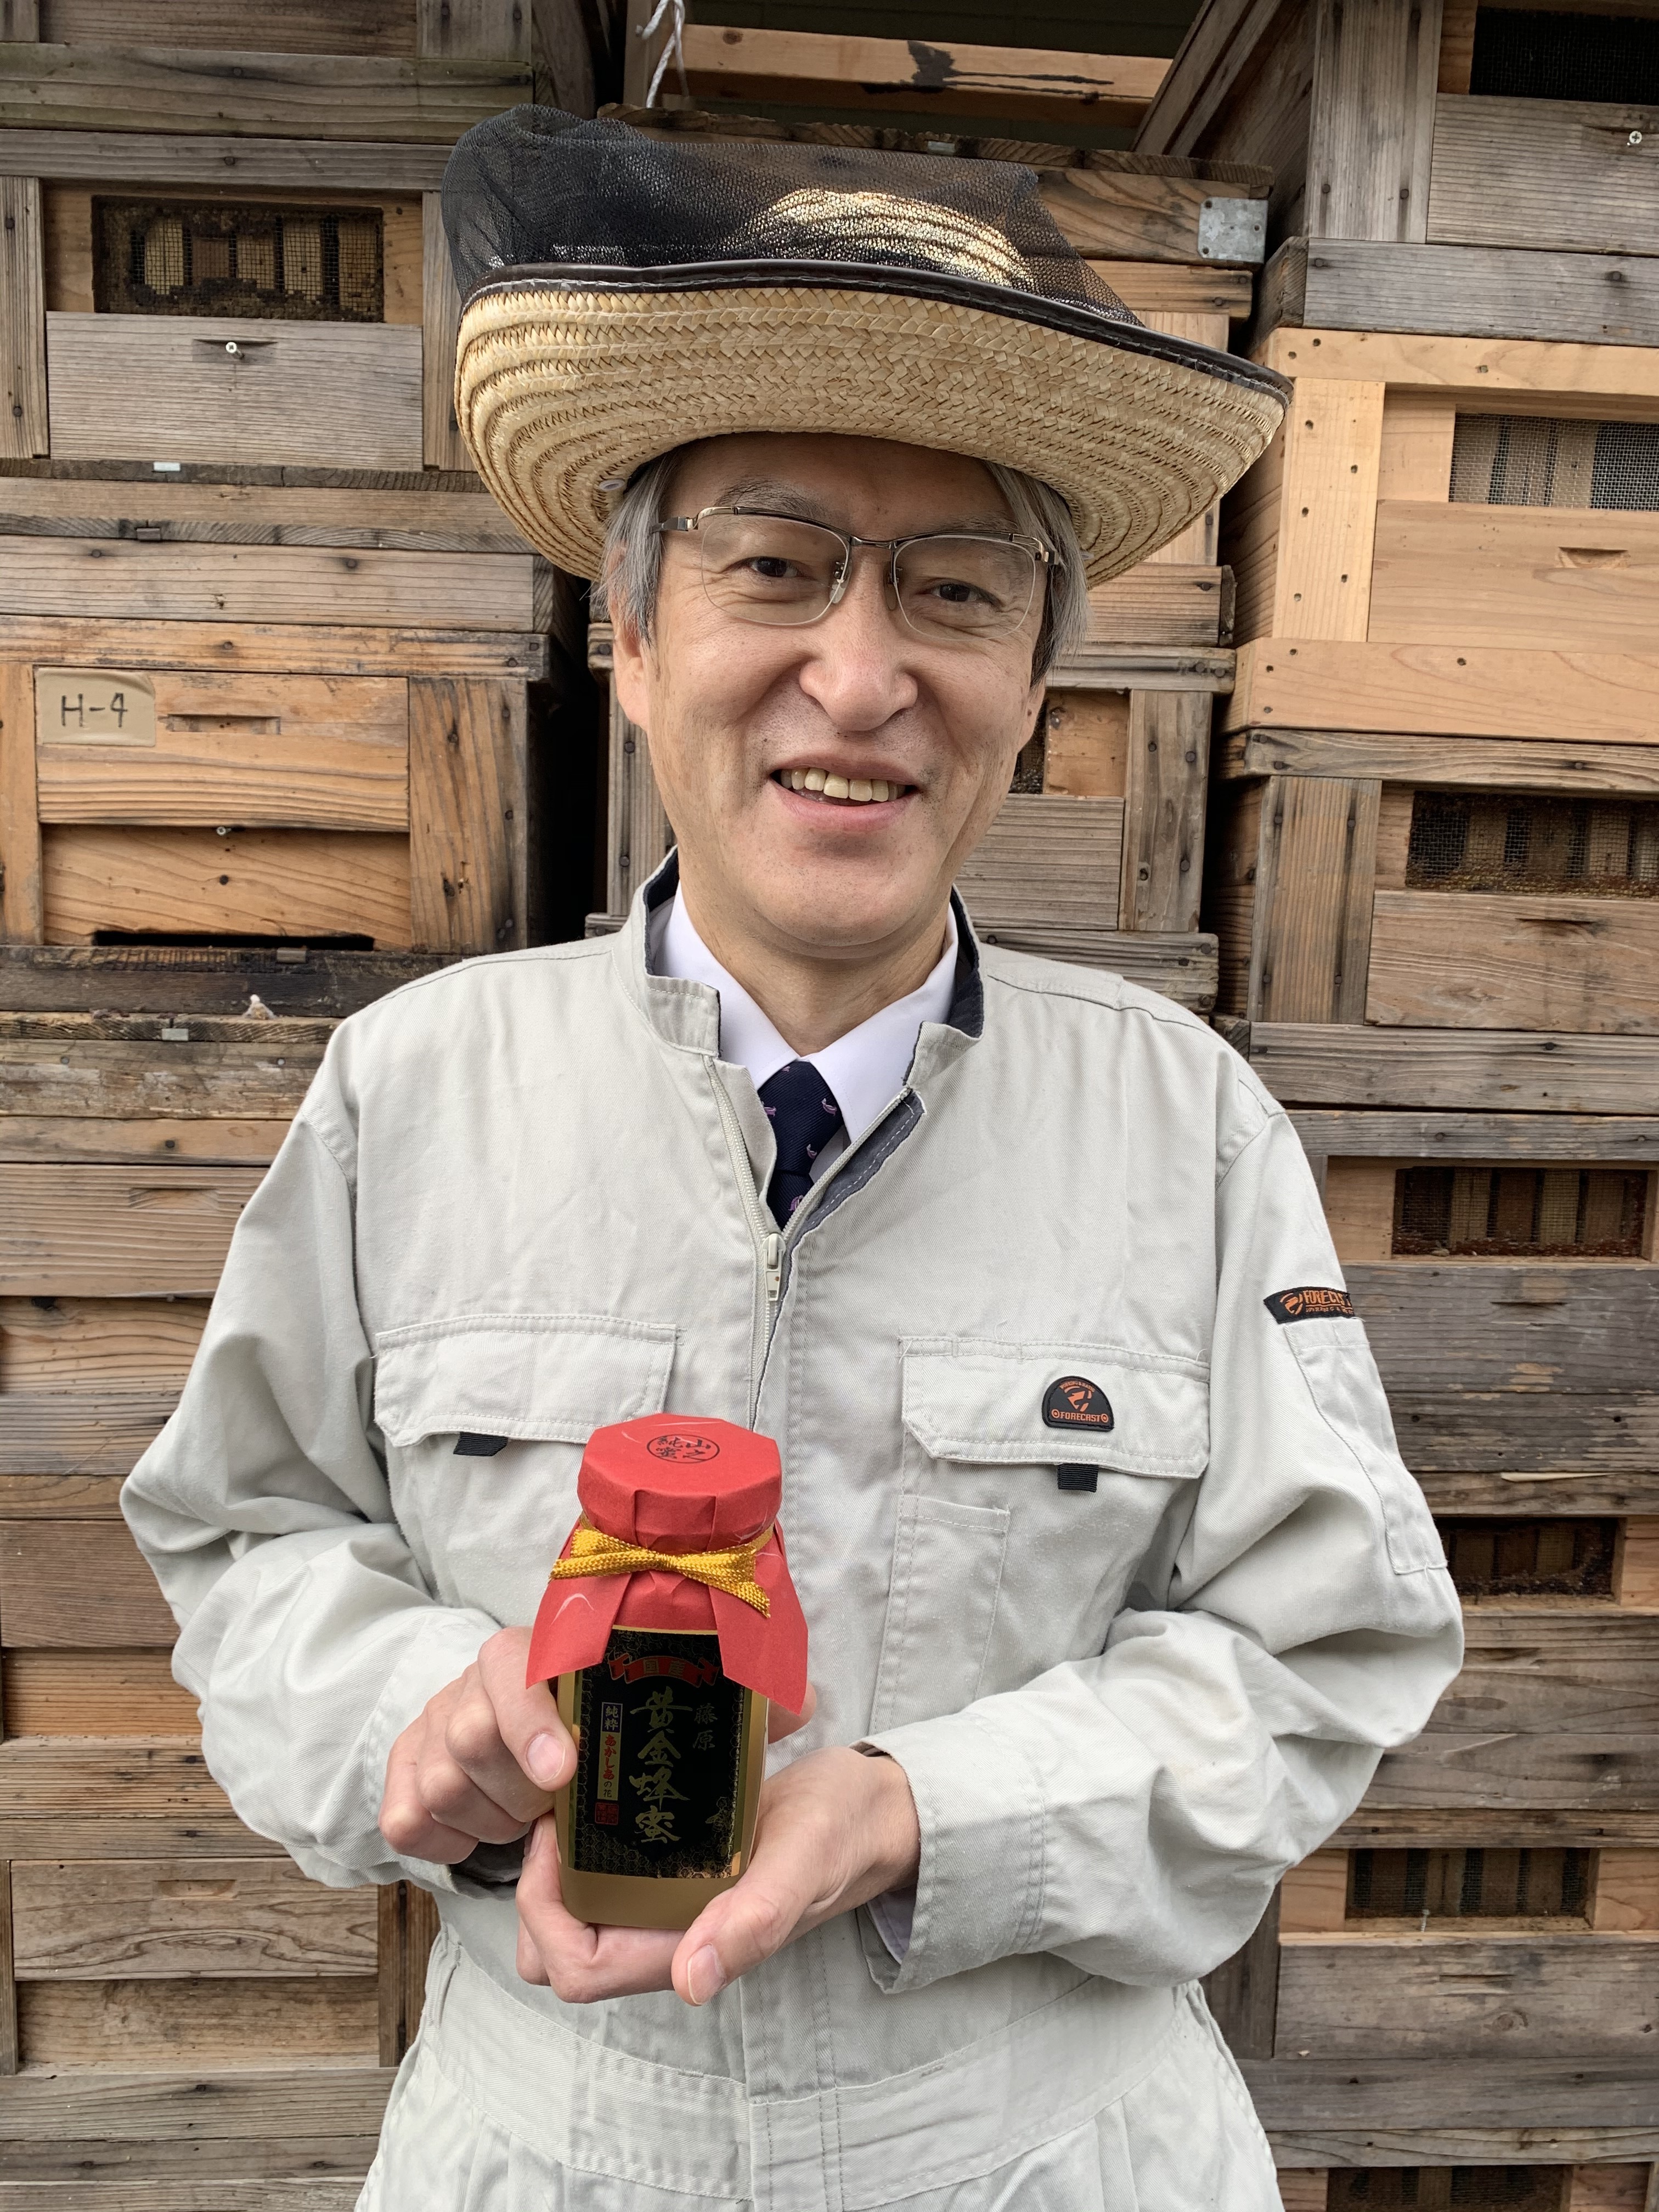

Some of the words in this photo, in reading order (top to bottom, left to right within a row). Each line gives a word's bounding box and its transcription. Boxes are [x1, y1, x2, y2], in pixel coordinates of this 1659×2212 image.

[61, 692, 128, 728] H-4
[1060, 1412, 1101, 1423] FORECAST
[643, 1658, 686, 1677] 国産
[692, 1705, 718, 1750] 藤原
[629, 1686, 693, 1844] 黄金蜂蜜
